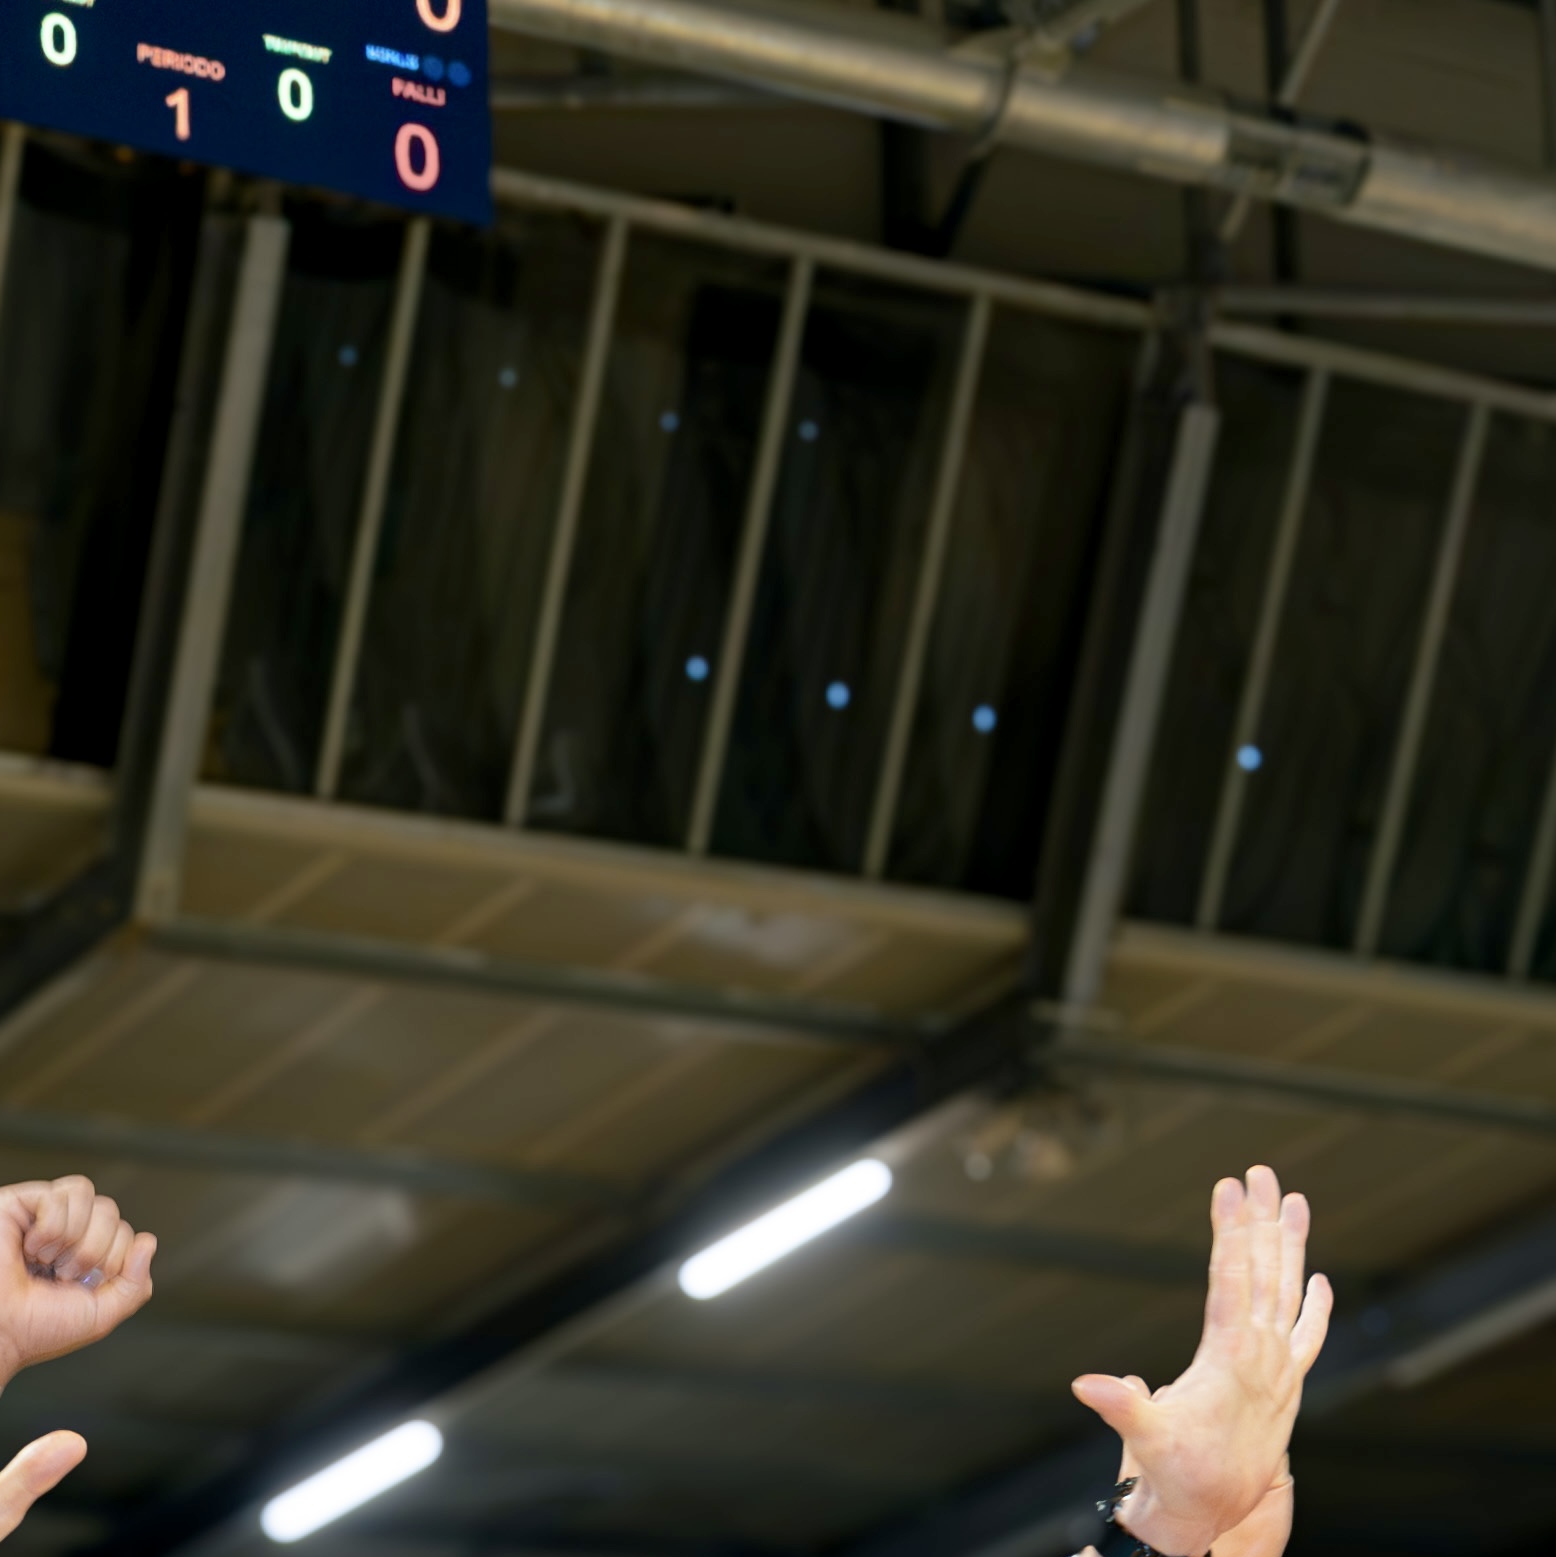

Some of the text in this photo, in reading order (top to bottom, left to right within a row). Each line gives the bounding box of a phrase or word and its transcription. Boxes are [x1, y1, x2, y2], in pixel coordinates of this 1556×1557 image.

[40, 12, 77, 66] 0
[136, 42, 226, 81] PERIODO
[165, 87, 191, 140] 1
[278, 67, 314, 122] 0
[394, 122, 441, 192] 0
